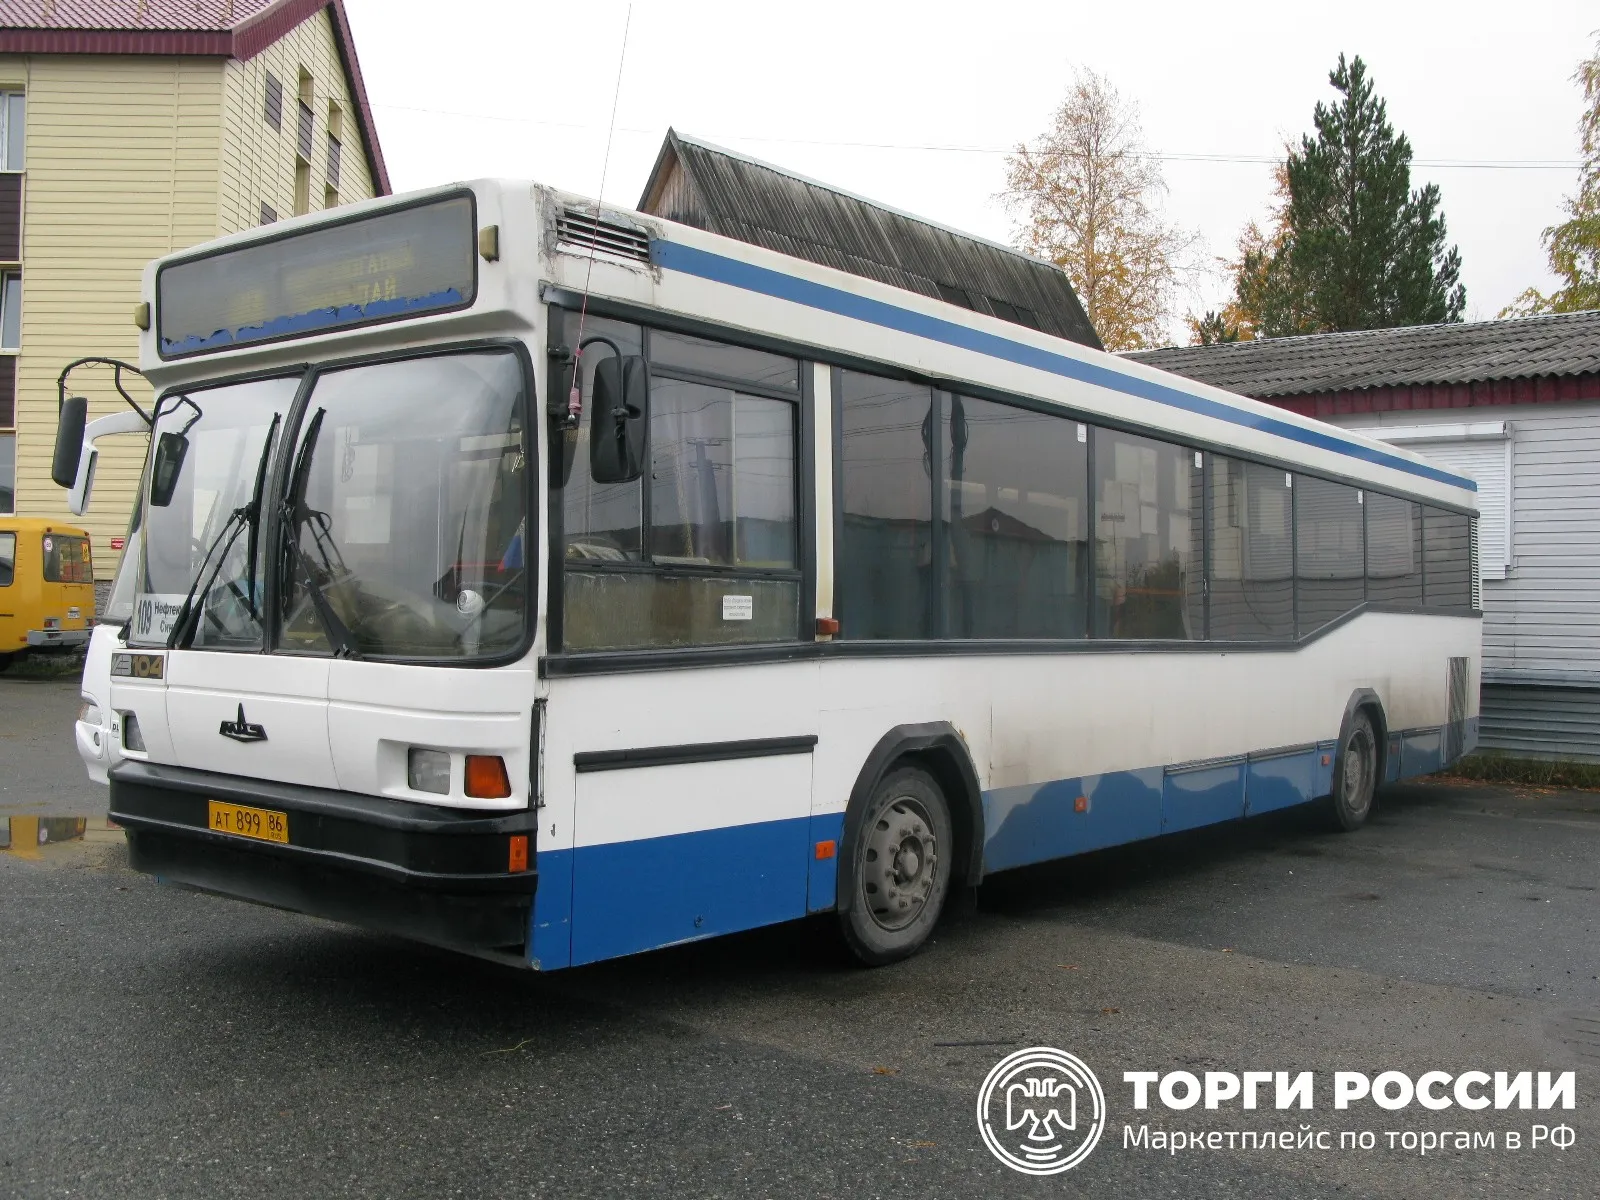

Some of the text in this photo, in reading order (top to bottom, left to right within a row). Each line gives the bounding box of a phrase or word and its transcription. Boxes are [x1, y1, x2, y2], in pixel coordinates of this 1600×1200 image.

[137, 599, 152, 635] 109
[132, 655, 163, 678] 104
[215, 810, 283, 834] АТ 899 86
